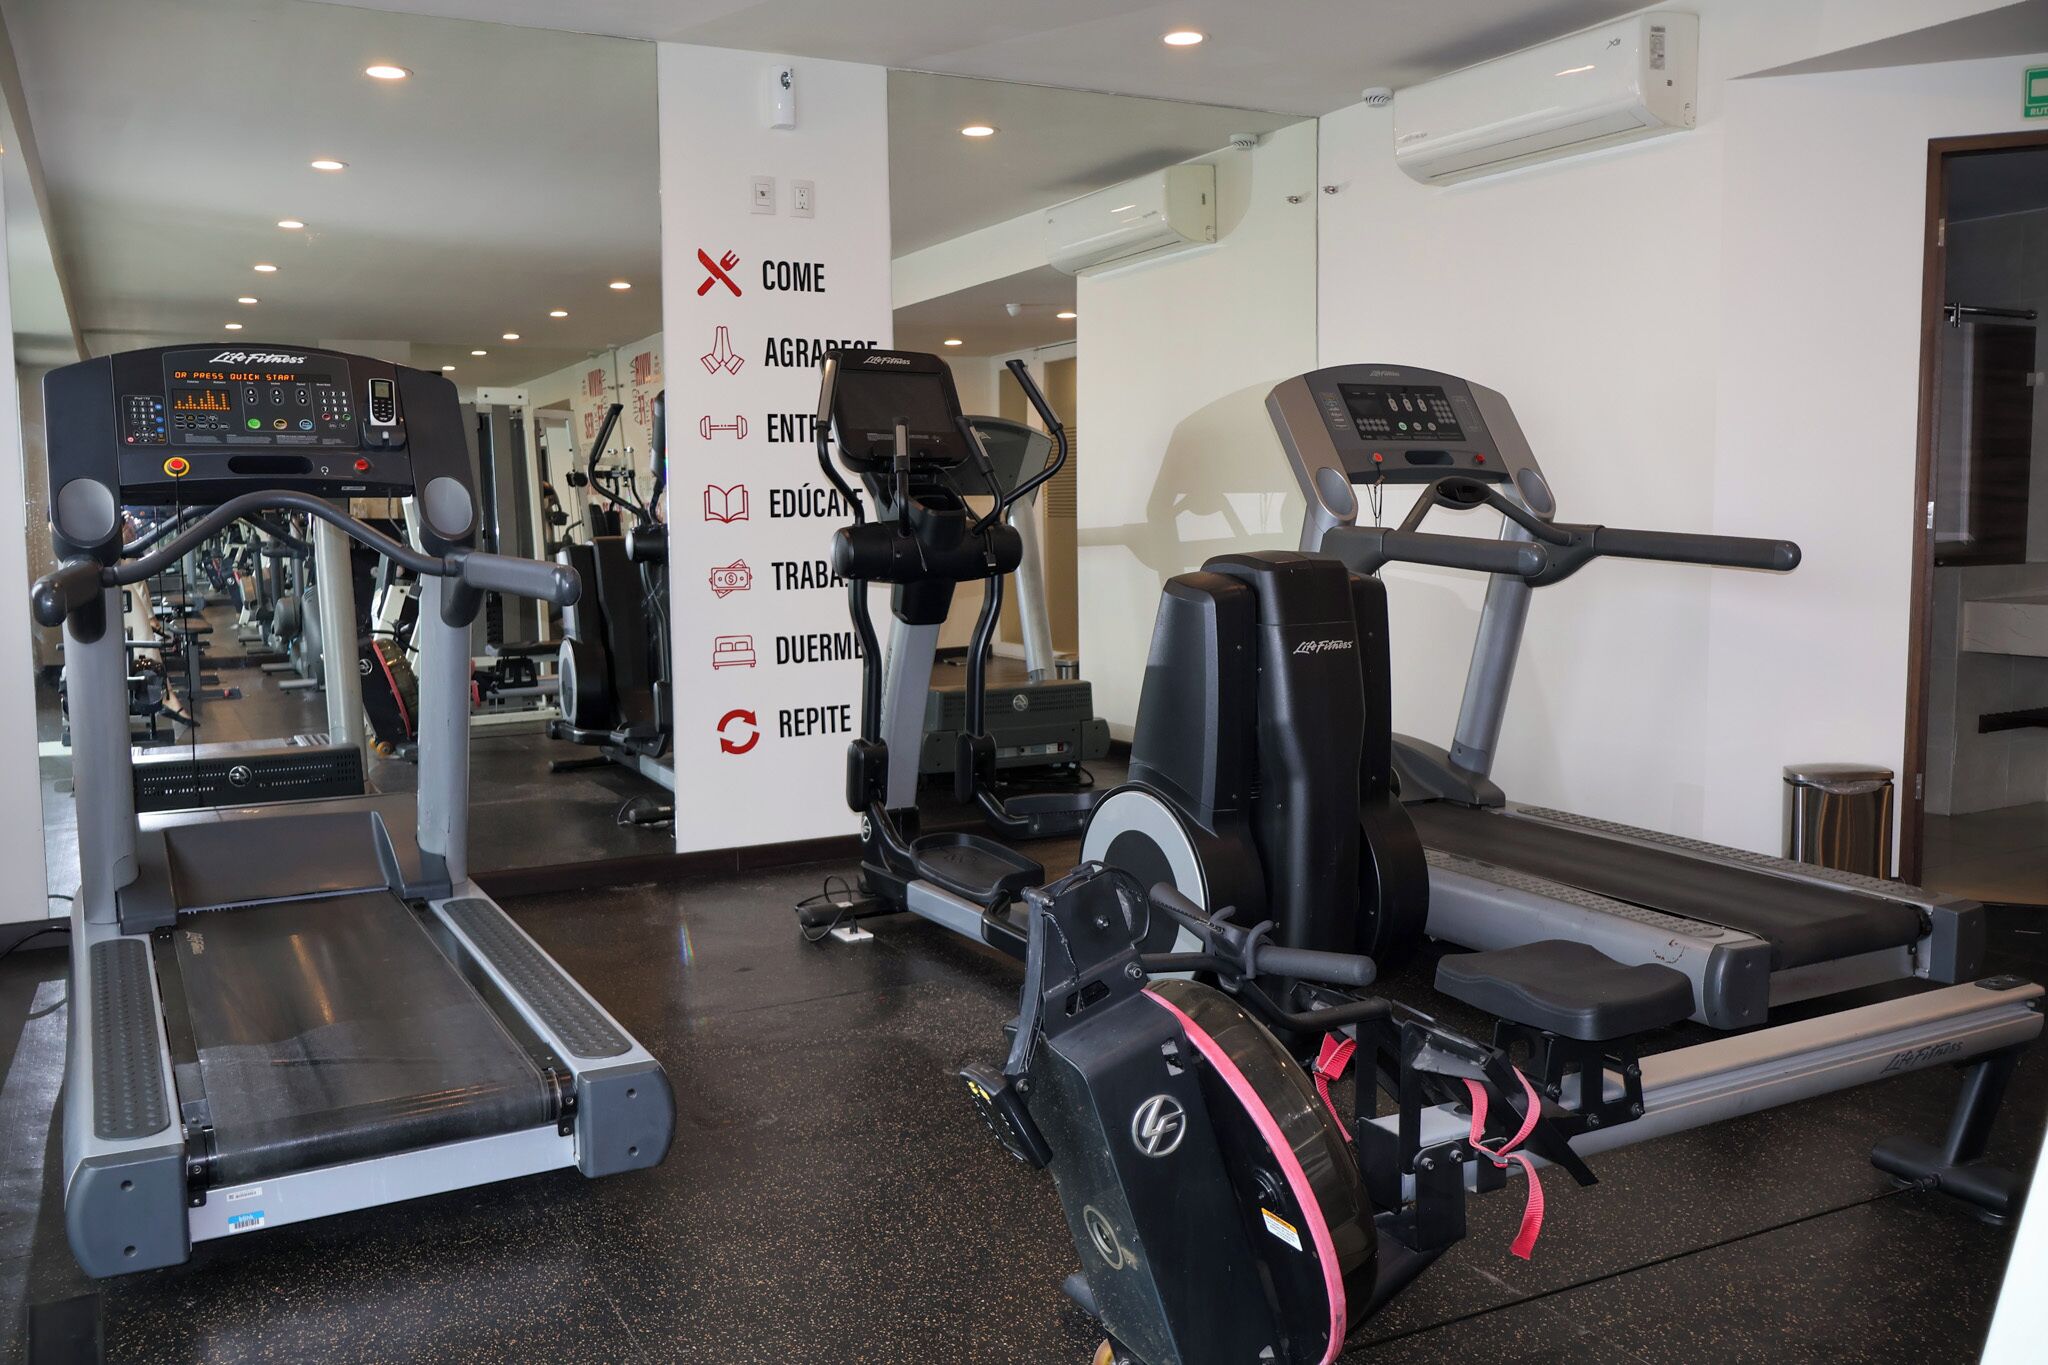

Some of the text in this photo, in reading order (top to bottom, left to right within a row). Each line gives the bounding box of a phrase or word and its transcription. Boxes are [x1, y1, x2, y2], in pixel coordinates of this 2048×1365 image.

[762, 260, 825, 293] COME
[209, 352, 305, 365] Life Fitness
[174, 371, 295, 382] OR PRESS QUICK START
[767, 413, 835, 443] ENTR
[771, 560, 849, 591] TRABA
[1292, 640, 1353, 655] Life Fitness
[779, 704, 852, 738] REPITE
